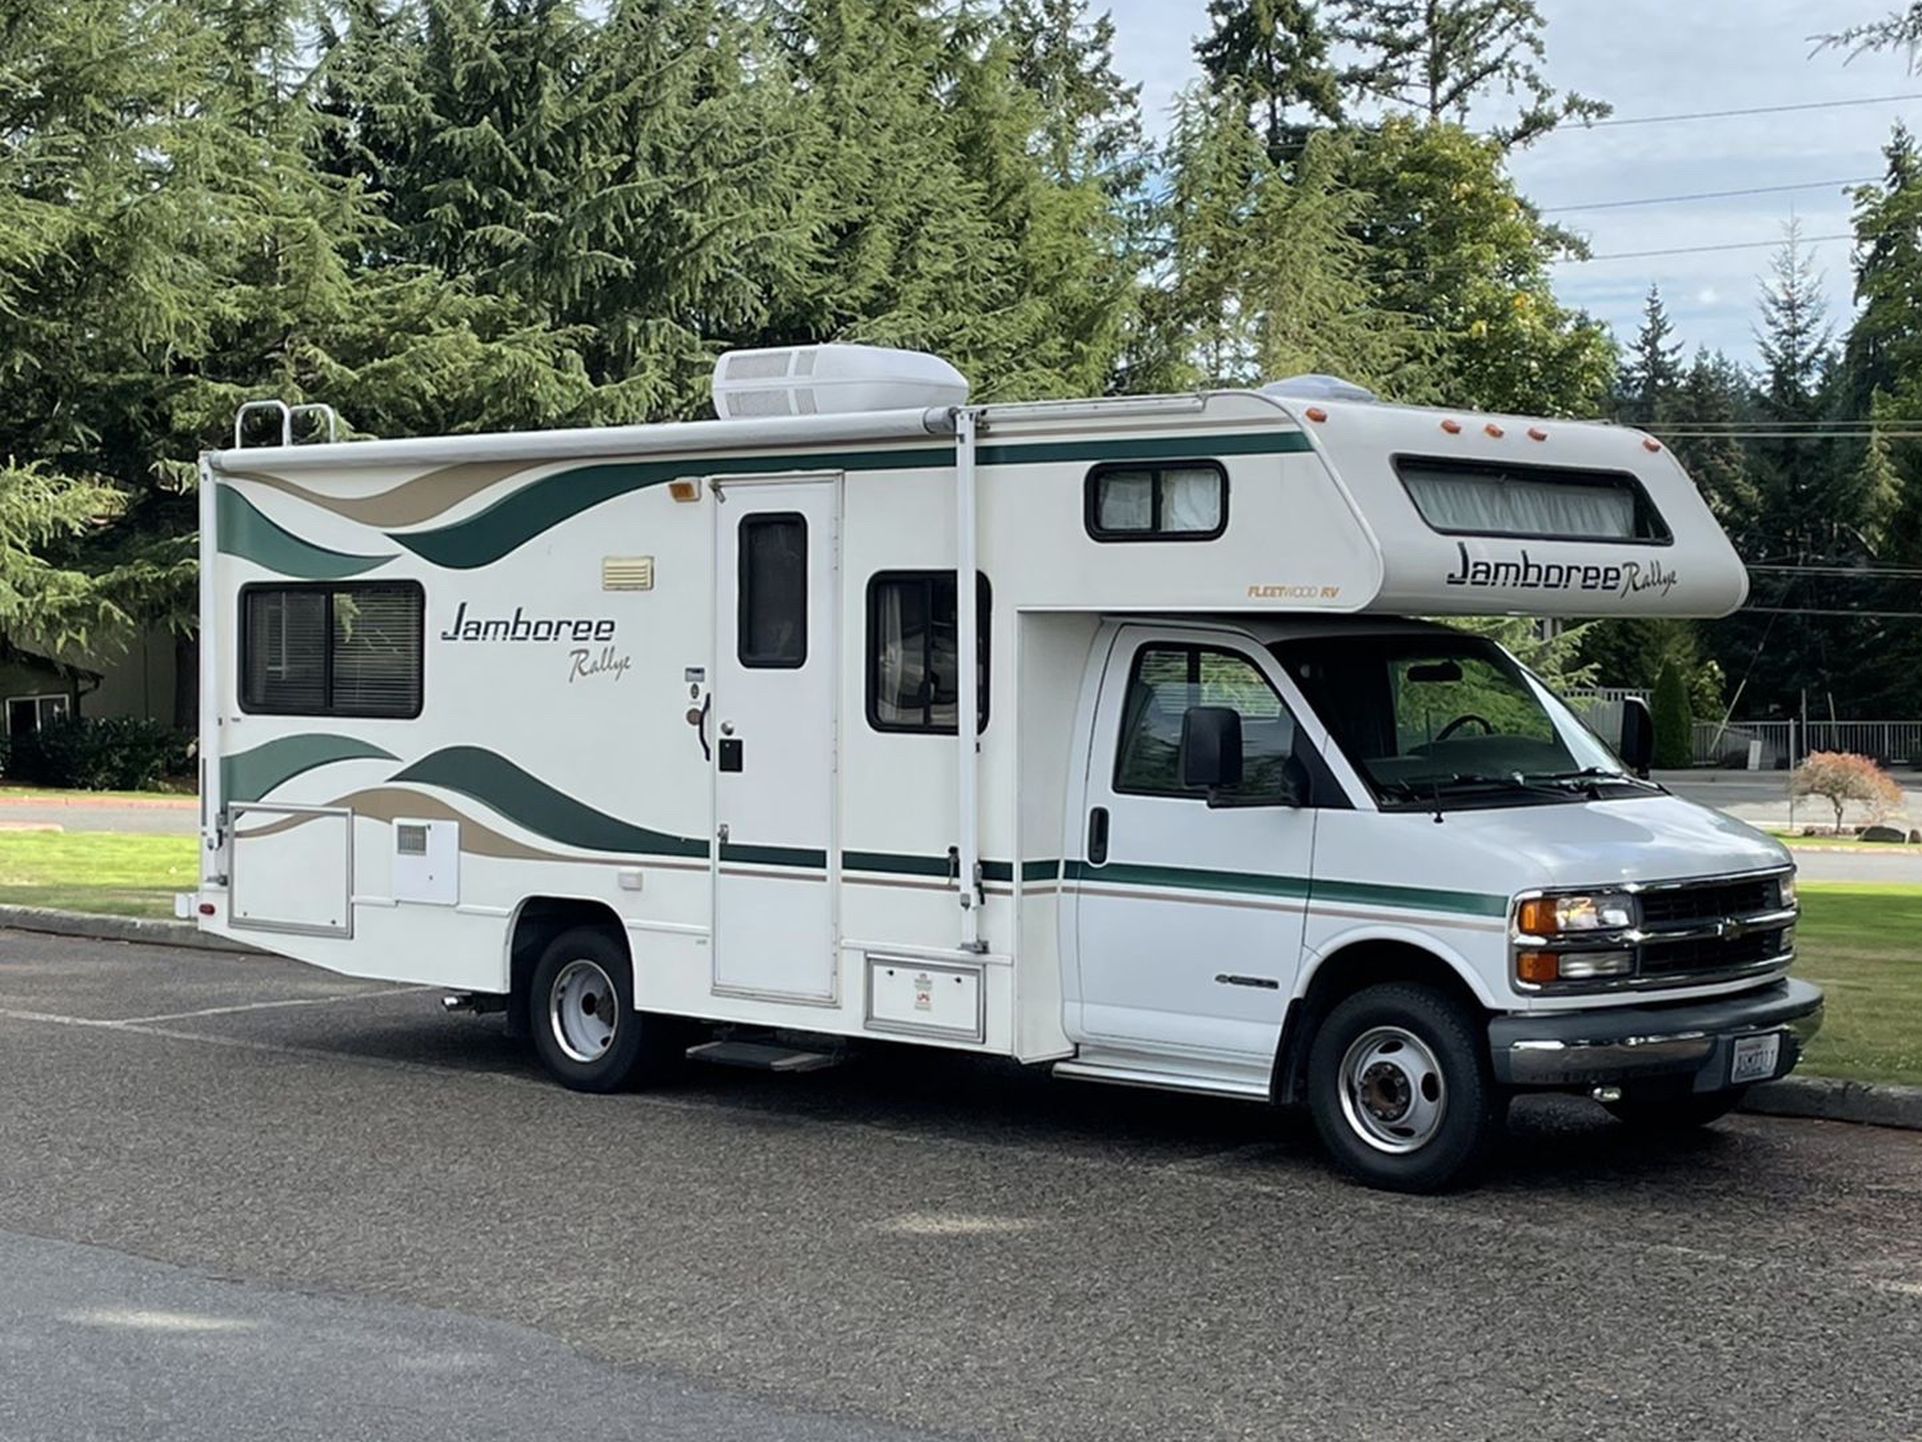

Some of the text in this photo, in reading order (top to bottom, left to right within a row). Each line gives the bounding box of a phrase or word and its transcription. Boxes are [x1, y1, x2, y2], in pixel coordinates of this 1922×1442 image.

[1446, 541, 1678, 599] Jamboree Rallye
[1247, 585, 1340, 598] FLEETWOOD RV
[440, 601, 616, 641] Jamboree
[568, 645, 631, 683] Rallye
